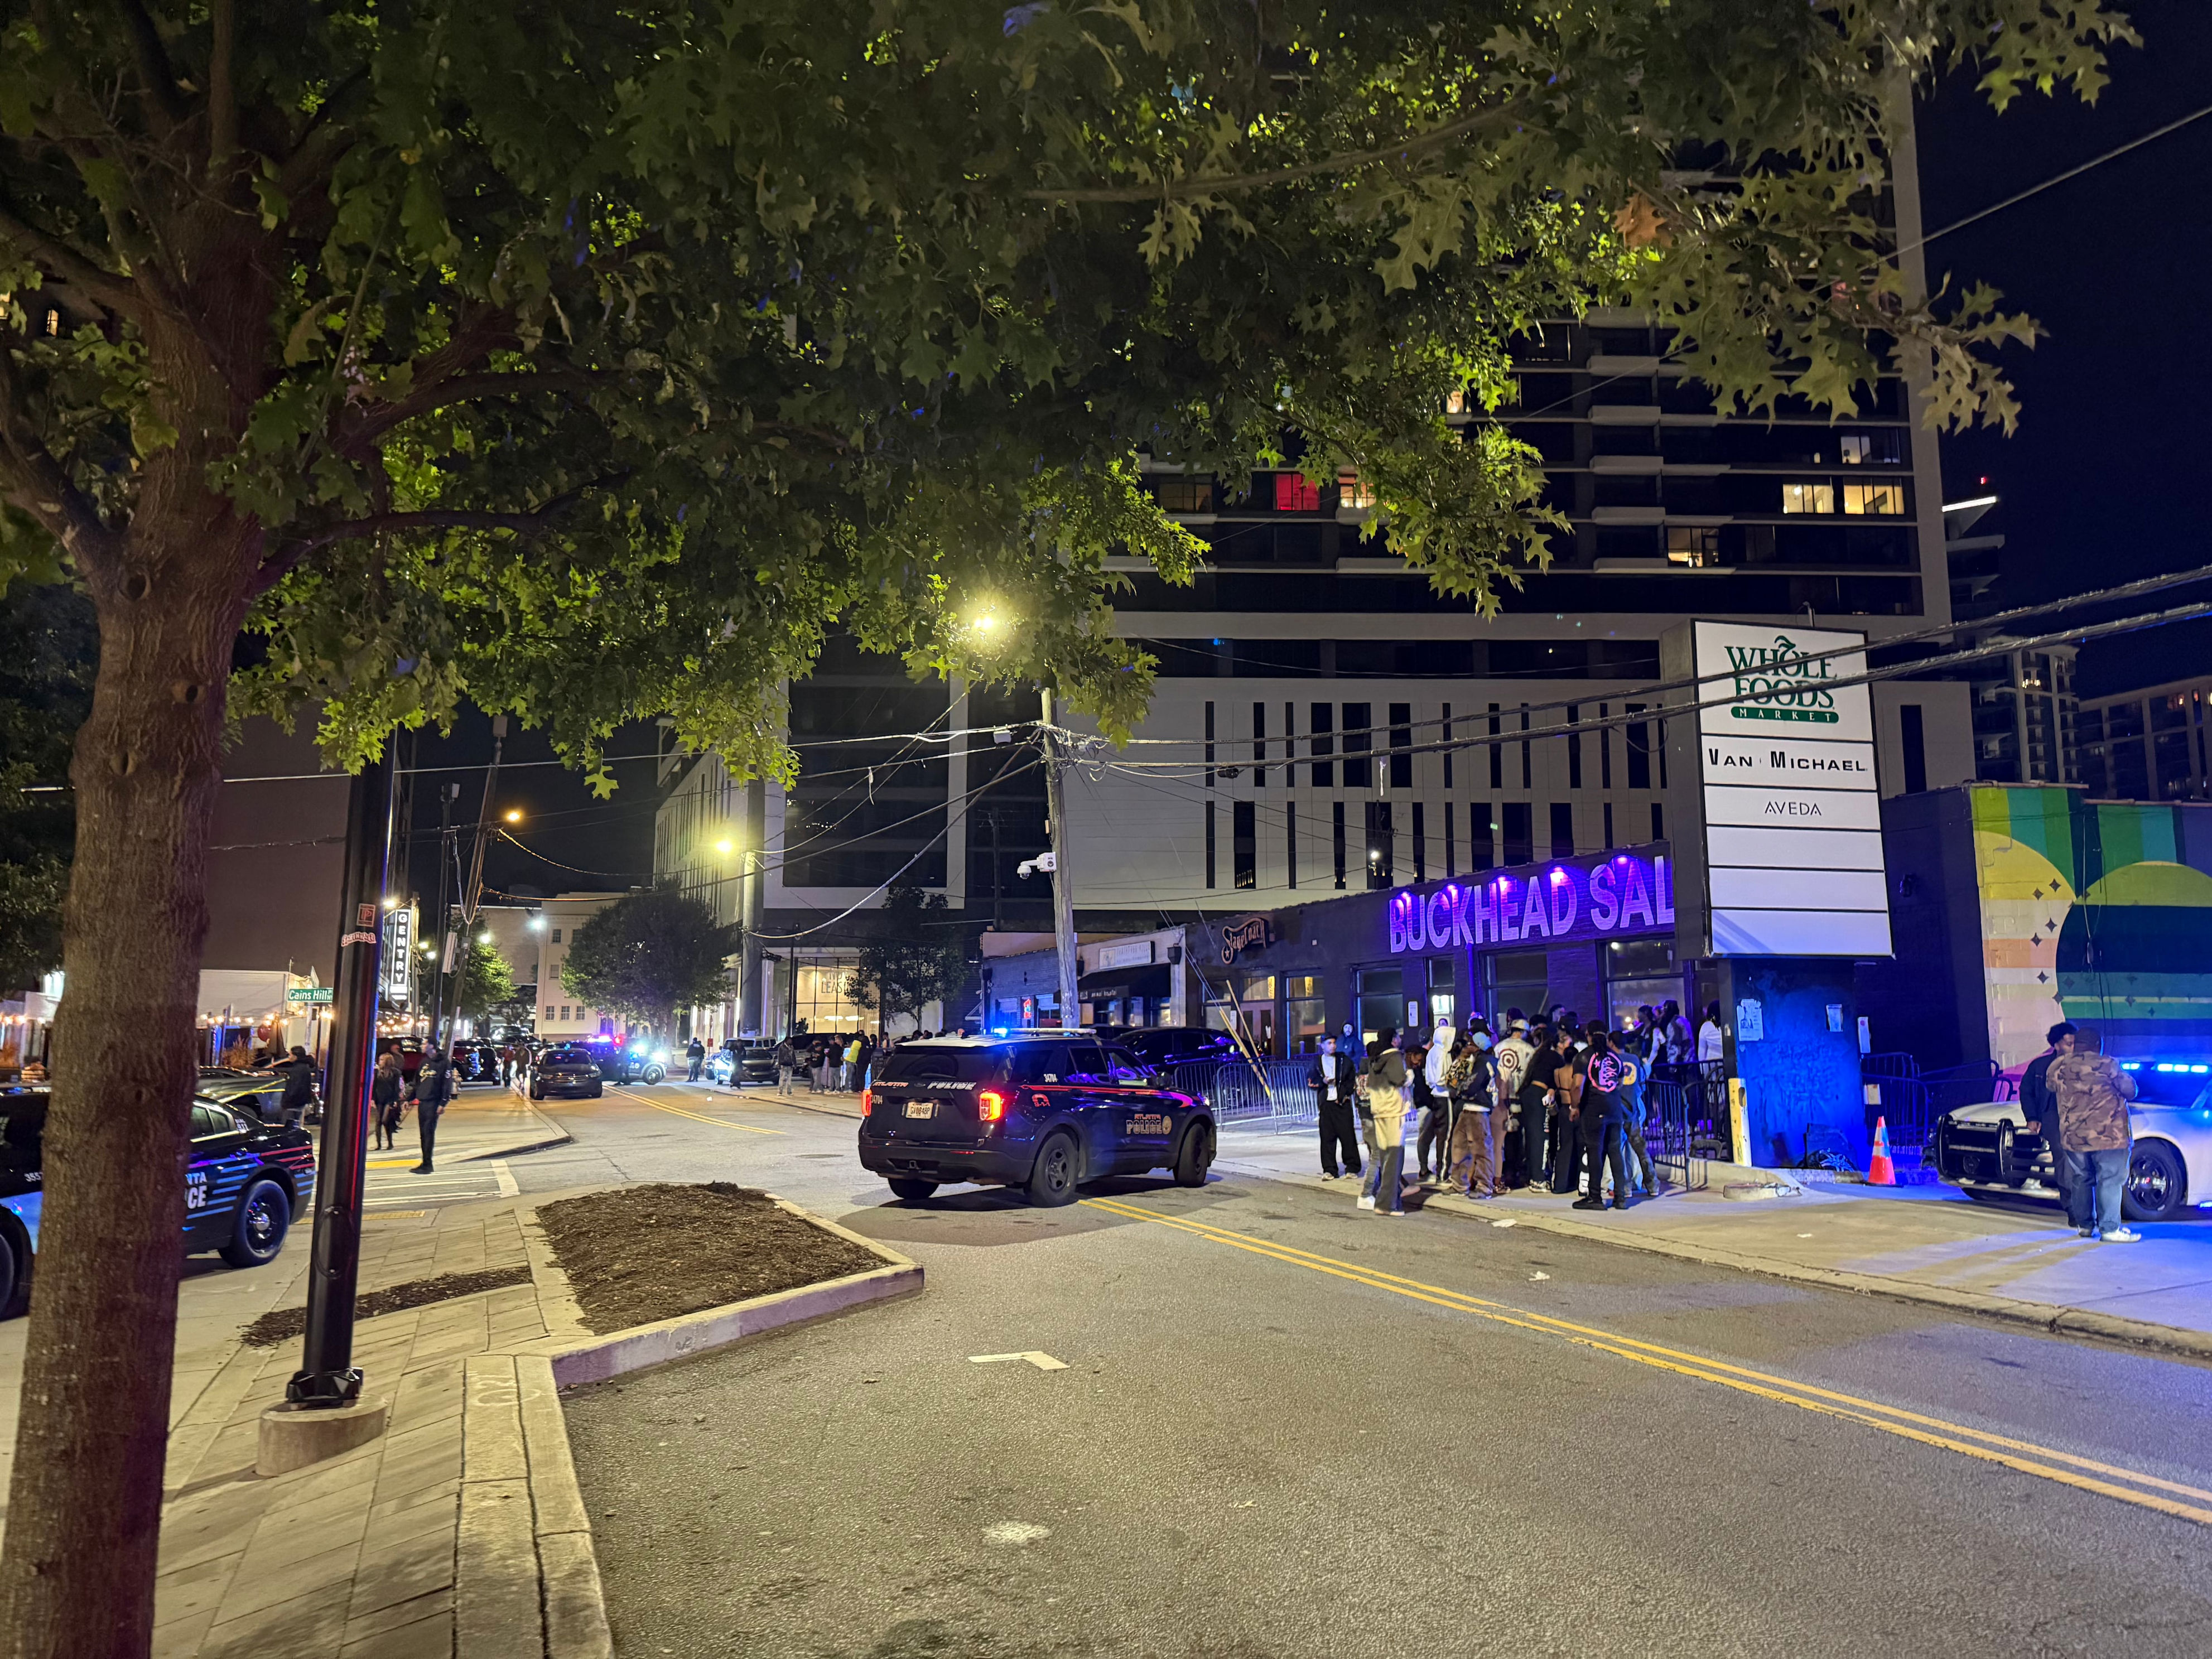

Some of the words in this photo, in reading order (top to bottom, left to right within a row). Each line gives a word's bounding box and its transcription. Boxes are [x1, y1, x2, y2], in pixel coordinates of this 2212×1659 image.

[1724, 645, 1837, 679] WHOLE
[1735, 677, 1834, 709] FOODS
[1739, 708, 1831, 722] MARKET
[1765, 801, 1821, 816] AVEDA
[1389, 866, 1578, 953] BUCKHEAD
[395, 914, 408, 982] GENTRY
[288, 990, 311, 1000] Cains
[313, 990, 327, 1000] Hill
[1043, 1073, 1058, 1083] 34704
[927, 1081, 977, 1091] POLICE
[1126, 1120, 1163, 1135] POLICE
